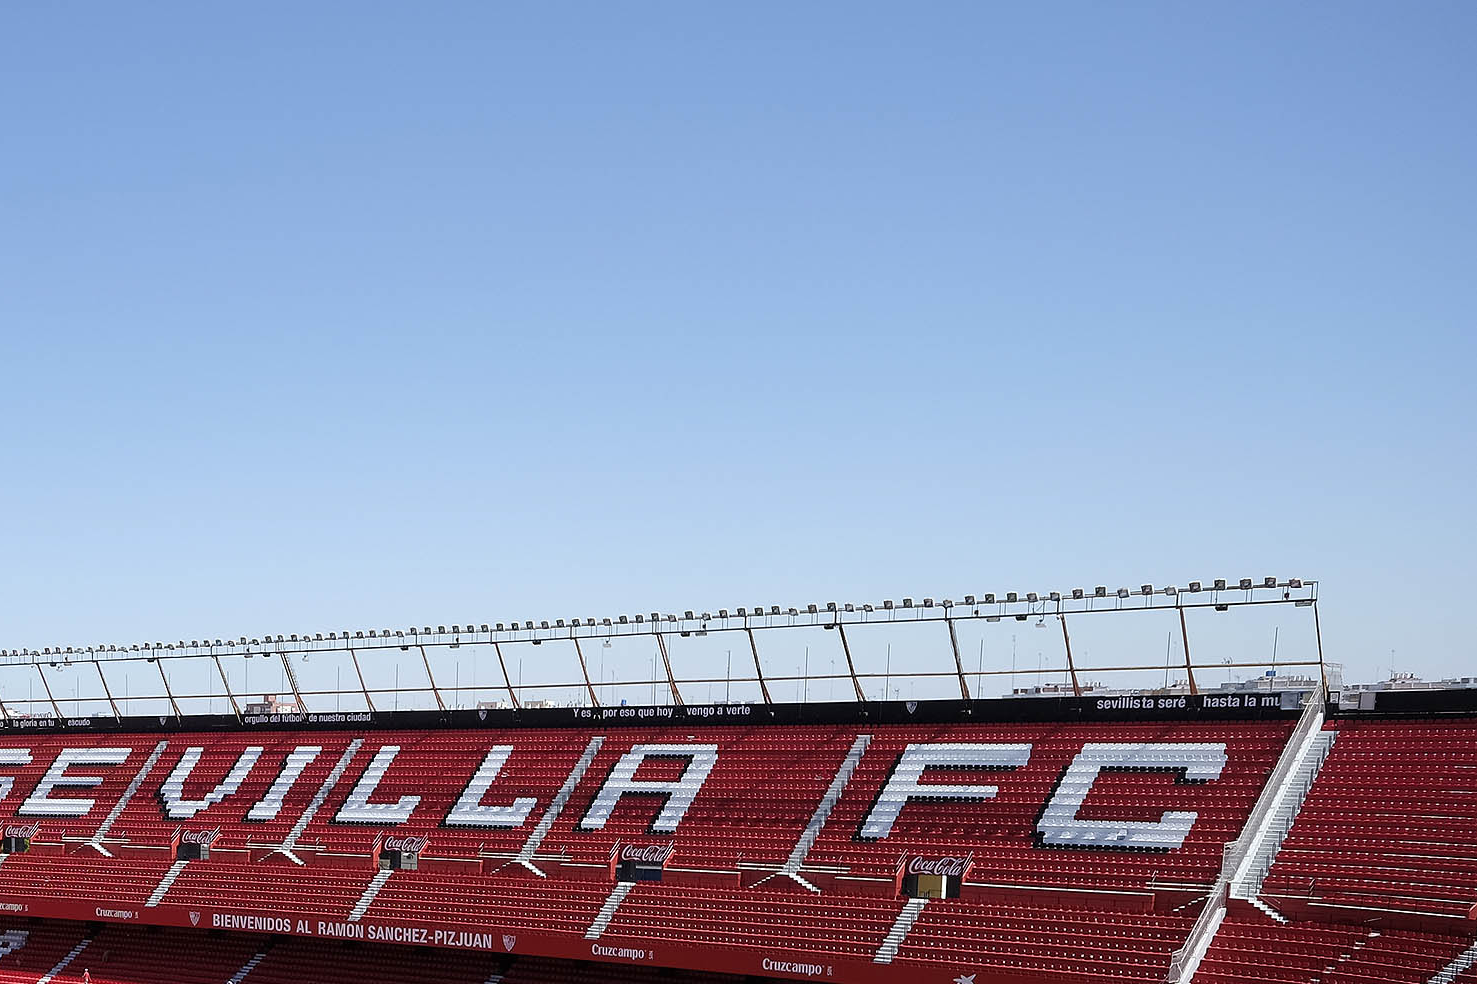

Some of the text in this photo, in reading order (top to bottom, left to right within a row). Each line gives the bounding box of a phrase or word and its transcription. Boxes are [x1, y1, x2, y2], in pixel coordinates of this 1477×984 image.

[1097, 695, 1154, 710] sevillista
[1157, 694, 1186, 709] seré
[1203, 694, 1240, 708] hasta
[1244, 694, 1256, 707] la
[245, 714, 269, 724] orgullo
[270, 714, 281, 723] del
[308, 714, 318, 723] de
[318, 713, 346, 722] nuestra
[347, 712, 371, 722] ciudad
[581, 710, 591, 718] es
[603, 709, 618, 719] por
[620, 709, 635, 718] eso
[638, 709, 654, 719] que
[657, 707, 673, 718] hoy
[687, 707, 715, 717] vengo
[717, 707, 723, 716] a
[726, 706, 751, 716] verte
[852, 743, 1228, 850] FC
[95, 906, 134, 919] Cruzcampo
[212, 913, 493, 949] BIENVENIDOS AL RAMON SANCHEZ-PIZJUAN
[591, 943, 645, 960] Cruzcampo
[762, 957, 823, 977] Cruzcampo
